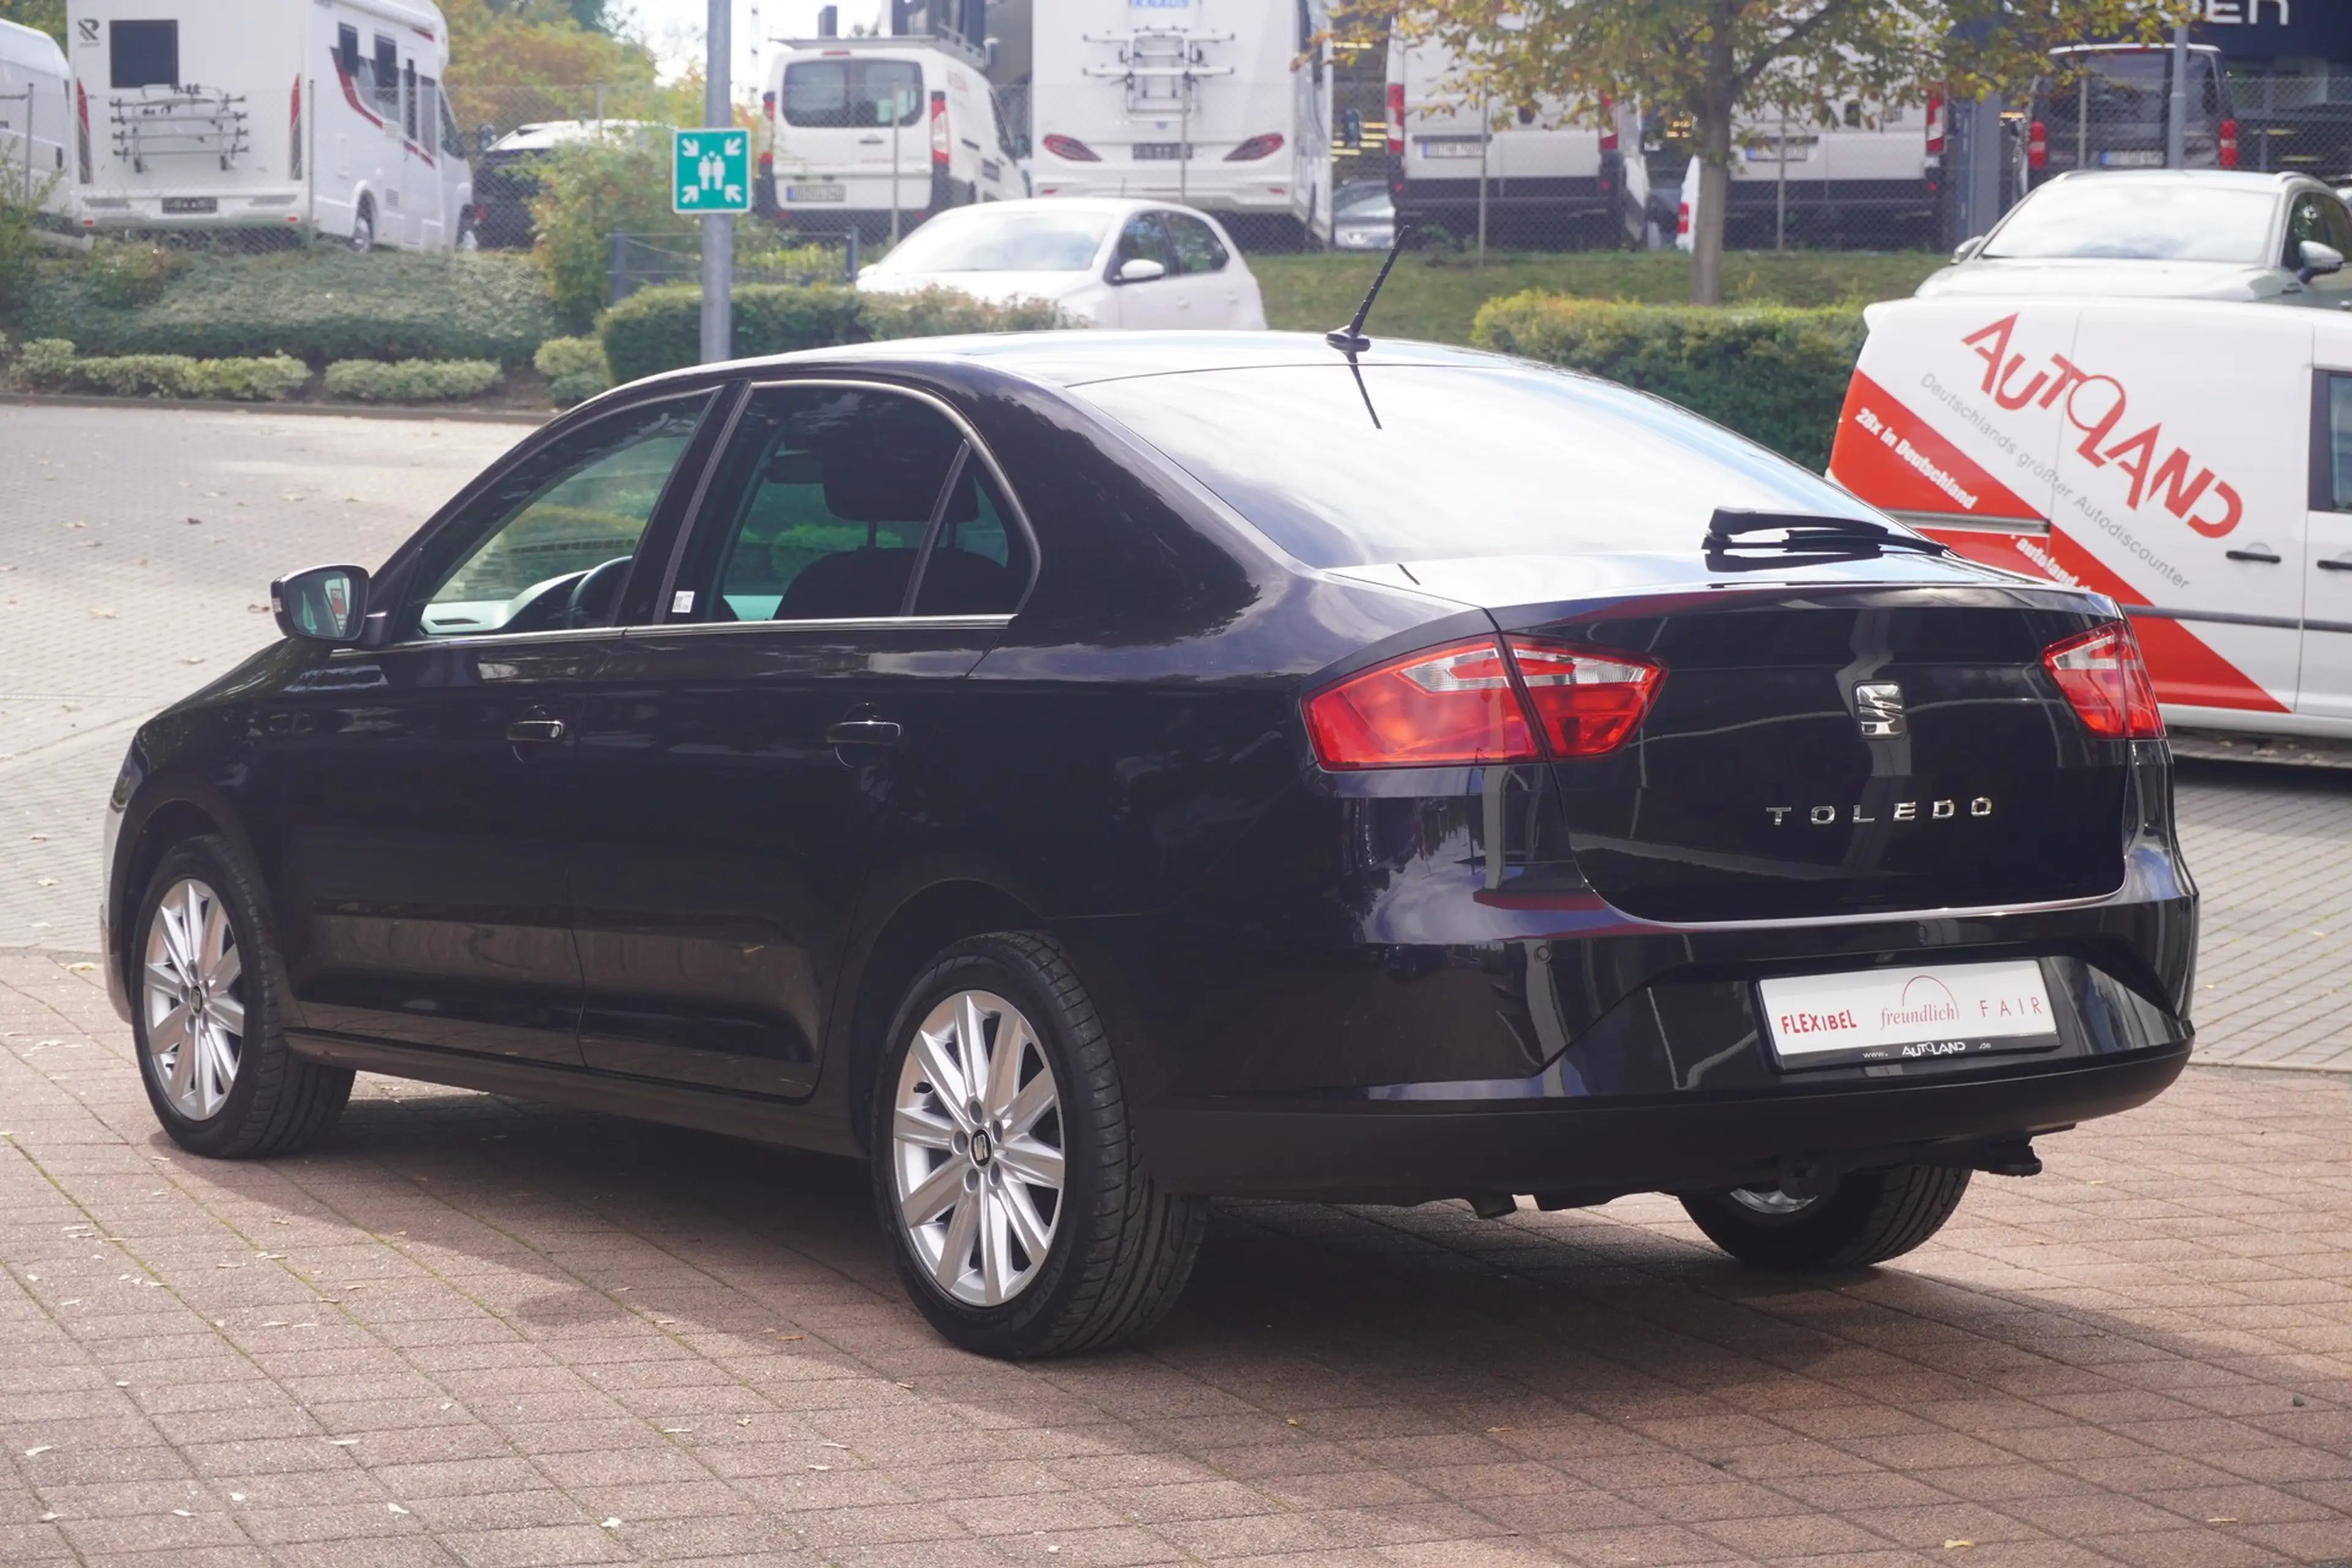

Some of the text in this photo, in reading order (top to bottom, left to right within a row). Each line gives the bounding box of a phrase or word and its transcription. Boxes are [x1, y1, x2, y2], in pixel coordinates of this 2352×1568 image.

[1961, 312, 2243, 539] AUTOLAND
[1880, 427, 1898, 448] in
[1894, 437, 1978, 511] Deutschland
[1920, 372, 2191, 590] Deutschlands größter Autodiscounter
[1765, 796, 1992, 826] TOLEDO
[1780, 996, 2042, 1035] FLEXIBEL freundlich FAIR
[1901, 1041, 1966, 1057] AUTOLAND
